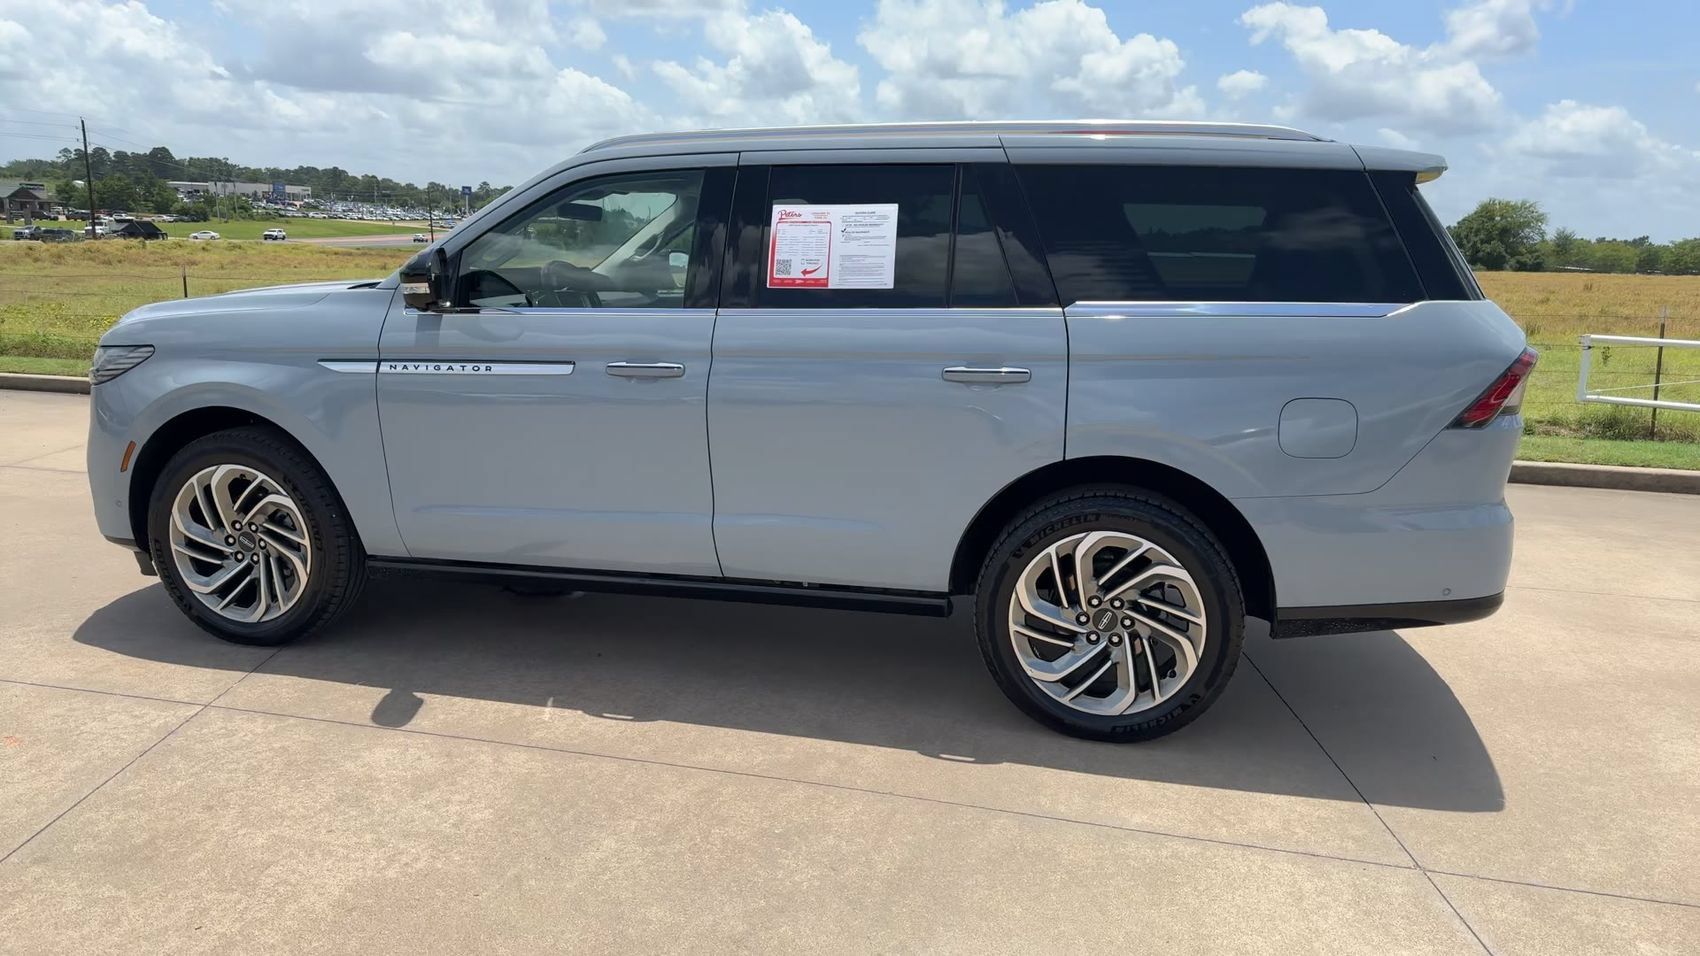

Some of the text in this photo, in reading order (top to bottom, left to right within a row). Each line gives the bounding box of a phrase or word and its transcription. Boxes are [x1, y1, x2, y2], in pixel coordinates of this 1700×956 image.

[389, 364, 492, 372] NAVIGATOR
[1029, 512, 1101, 545] MICHELIN
[1110, 706, 1183, 734] MICHELIN
